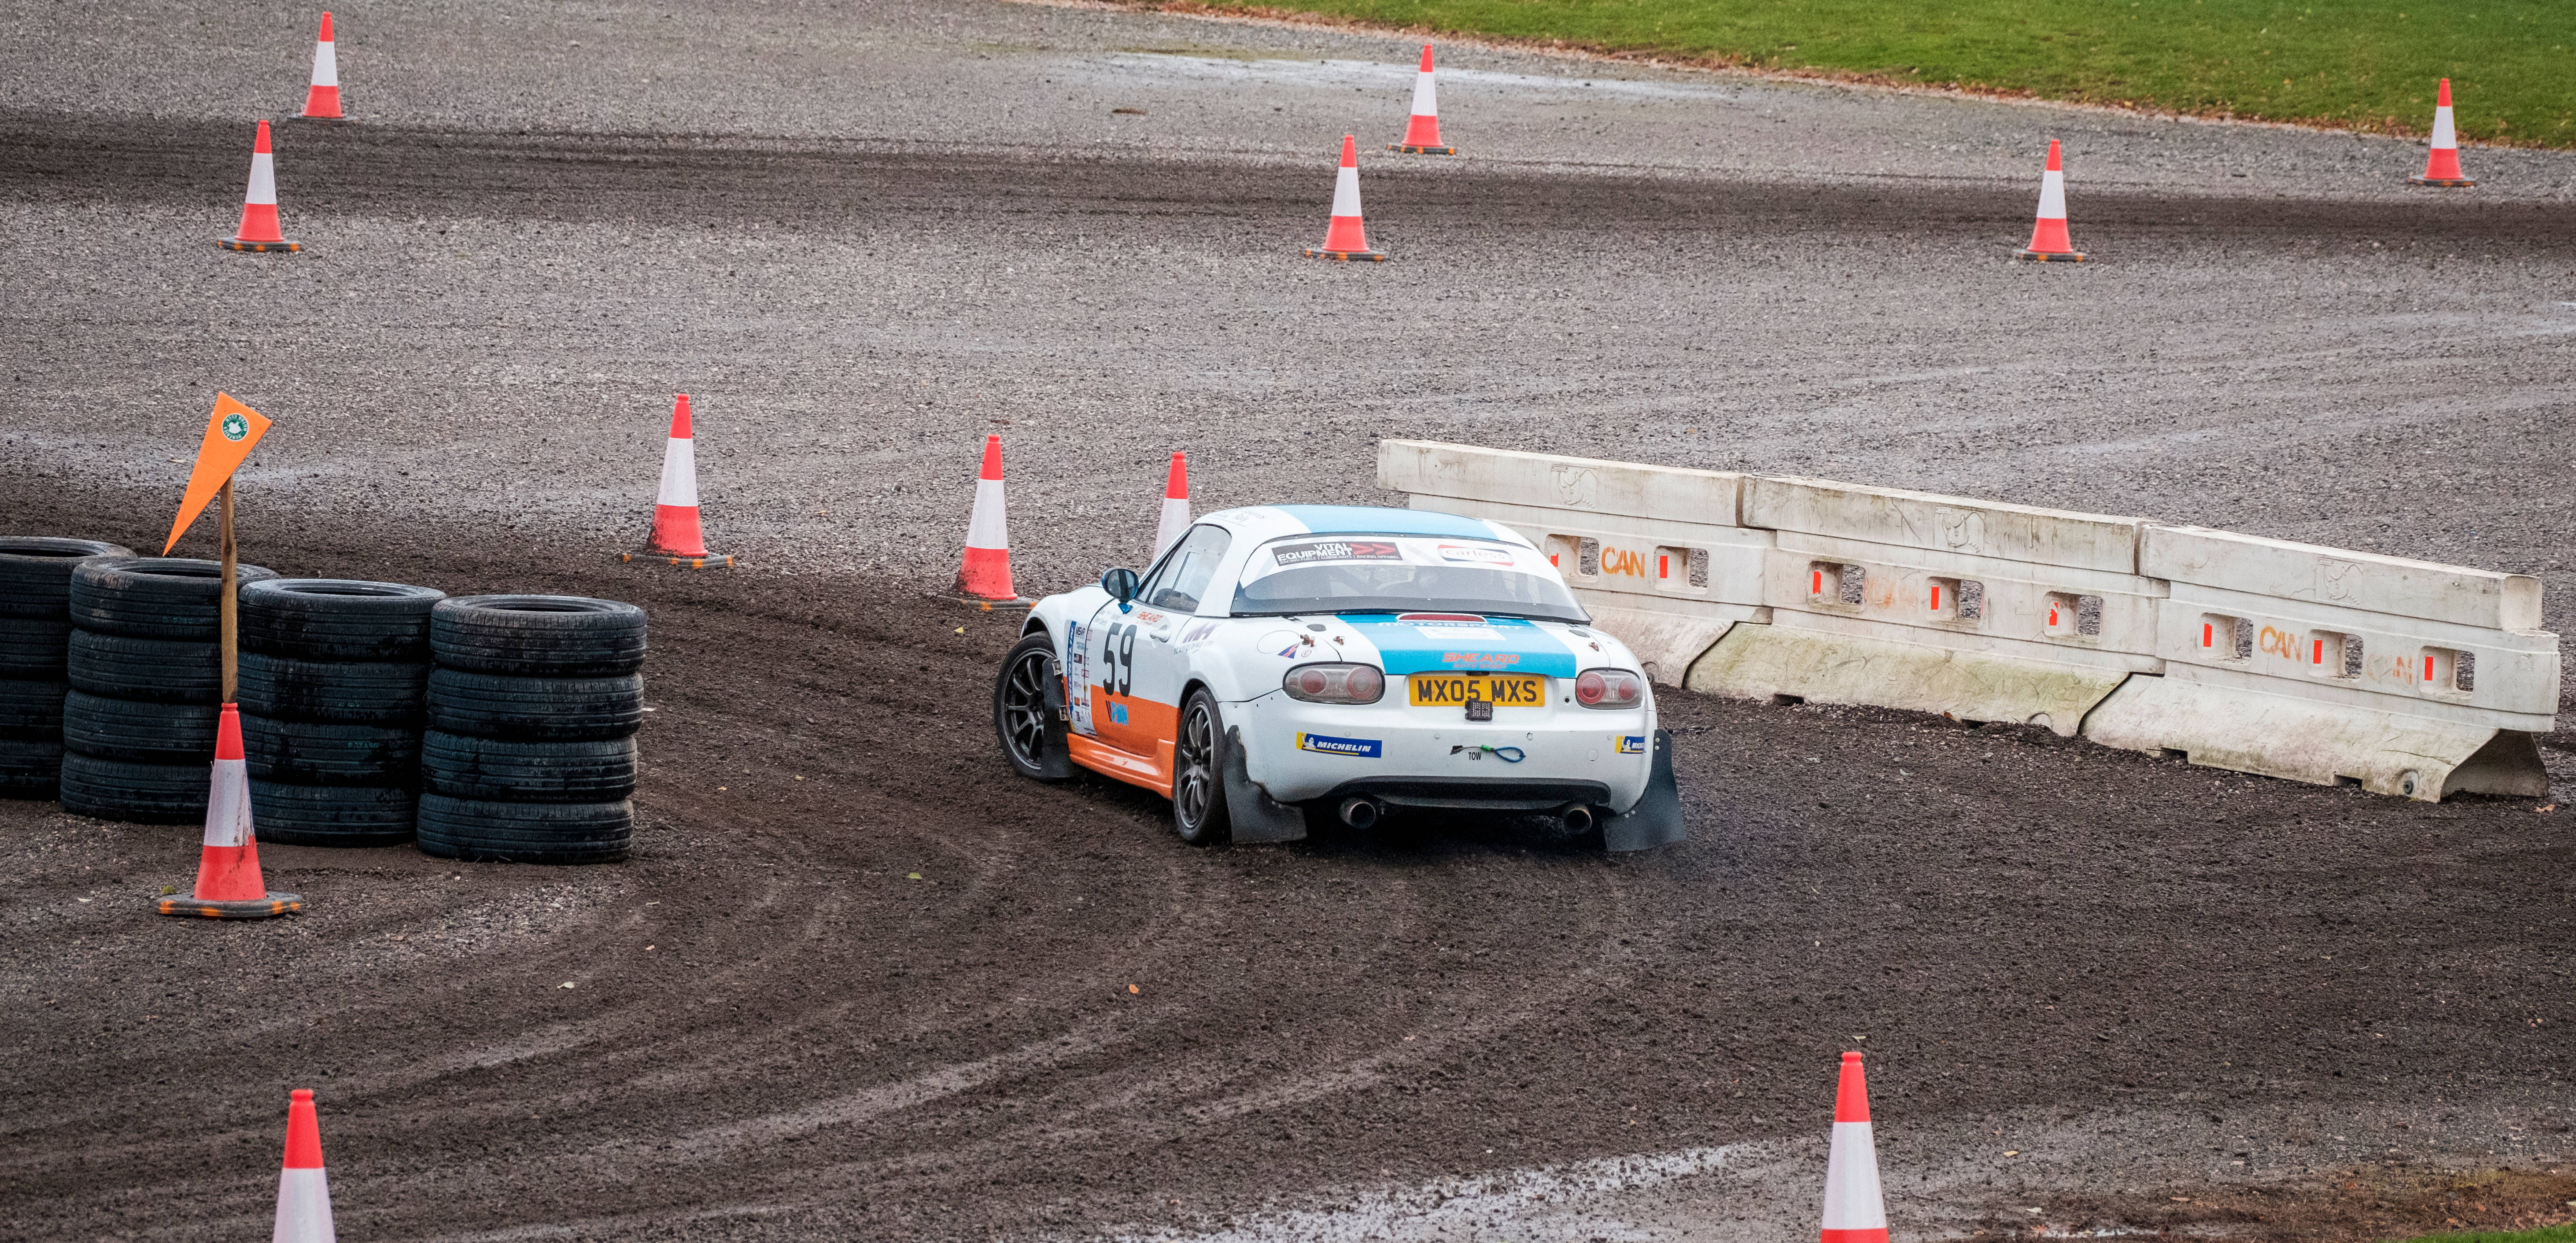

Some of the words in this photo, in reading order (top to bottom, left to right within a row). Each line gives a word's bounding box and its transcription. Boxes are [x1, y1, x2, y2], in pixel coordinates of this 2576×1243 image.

[1277, 548, 1353, 562] EQUIPMENT
[1446, 550, 1505, 559] carless
[1602, 546, 1645, 578] CAN
[1377, 621, 1525, 630] MOTORSPORT
[1173, 642, 1203, 655] SCAFFOLDING
[2259, 625, 2304, 662] CAN
[1103, 622, 1137, 697] 59
[1442, 653, 1520, 664] SHEARD
[1417, 680, 1480, 702] MX05
[1491, 680, 1537, 702] MXS
[1317, 741, 1371, 752] MICHELIN
[1468, 752, 1481, 760] TOW
